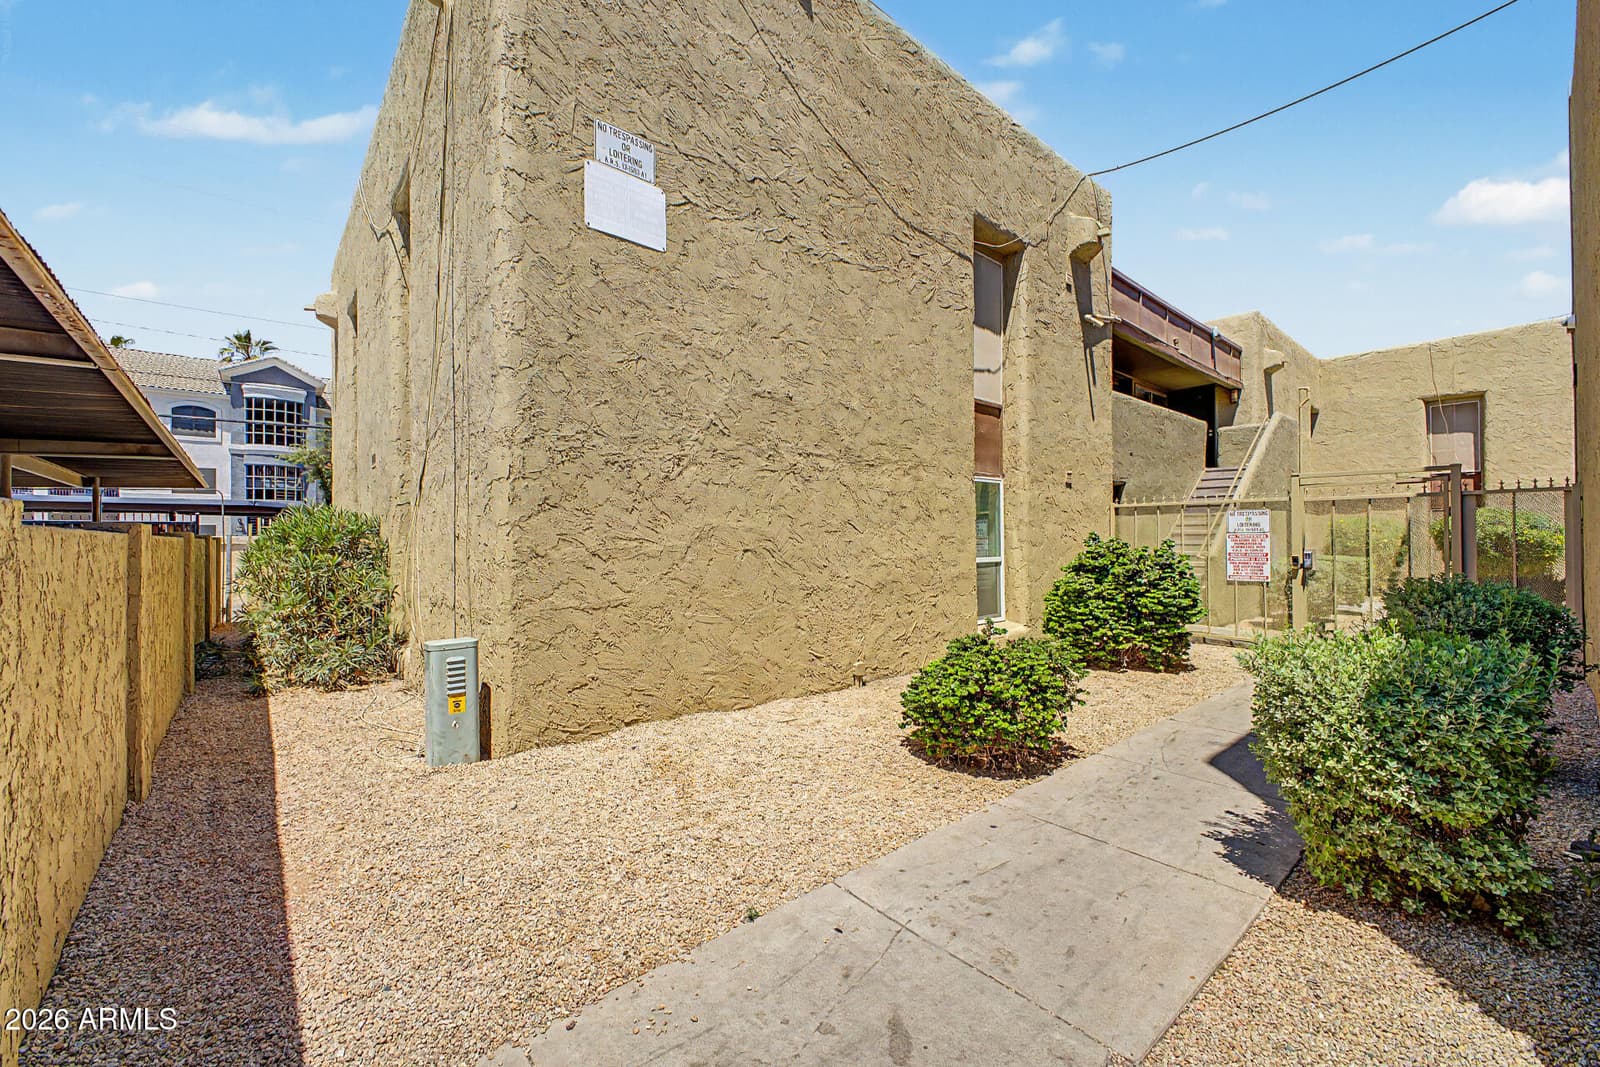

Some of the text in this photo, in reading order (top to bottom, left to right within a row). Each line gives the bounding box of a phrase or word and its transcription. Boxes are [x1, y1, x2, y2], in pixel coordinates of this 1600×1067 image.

[597, 121, 653, 153] NO TRESPASSING
[621, 142, 631, 154] OR
[608, 147, 643, 169] LOITERING
